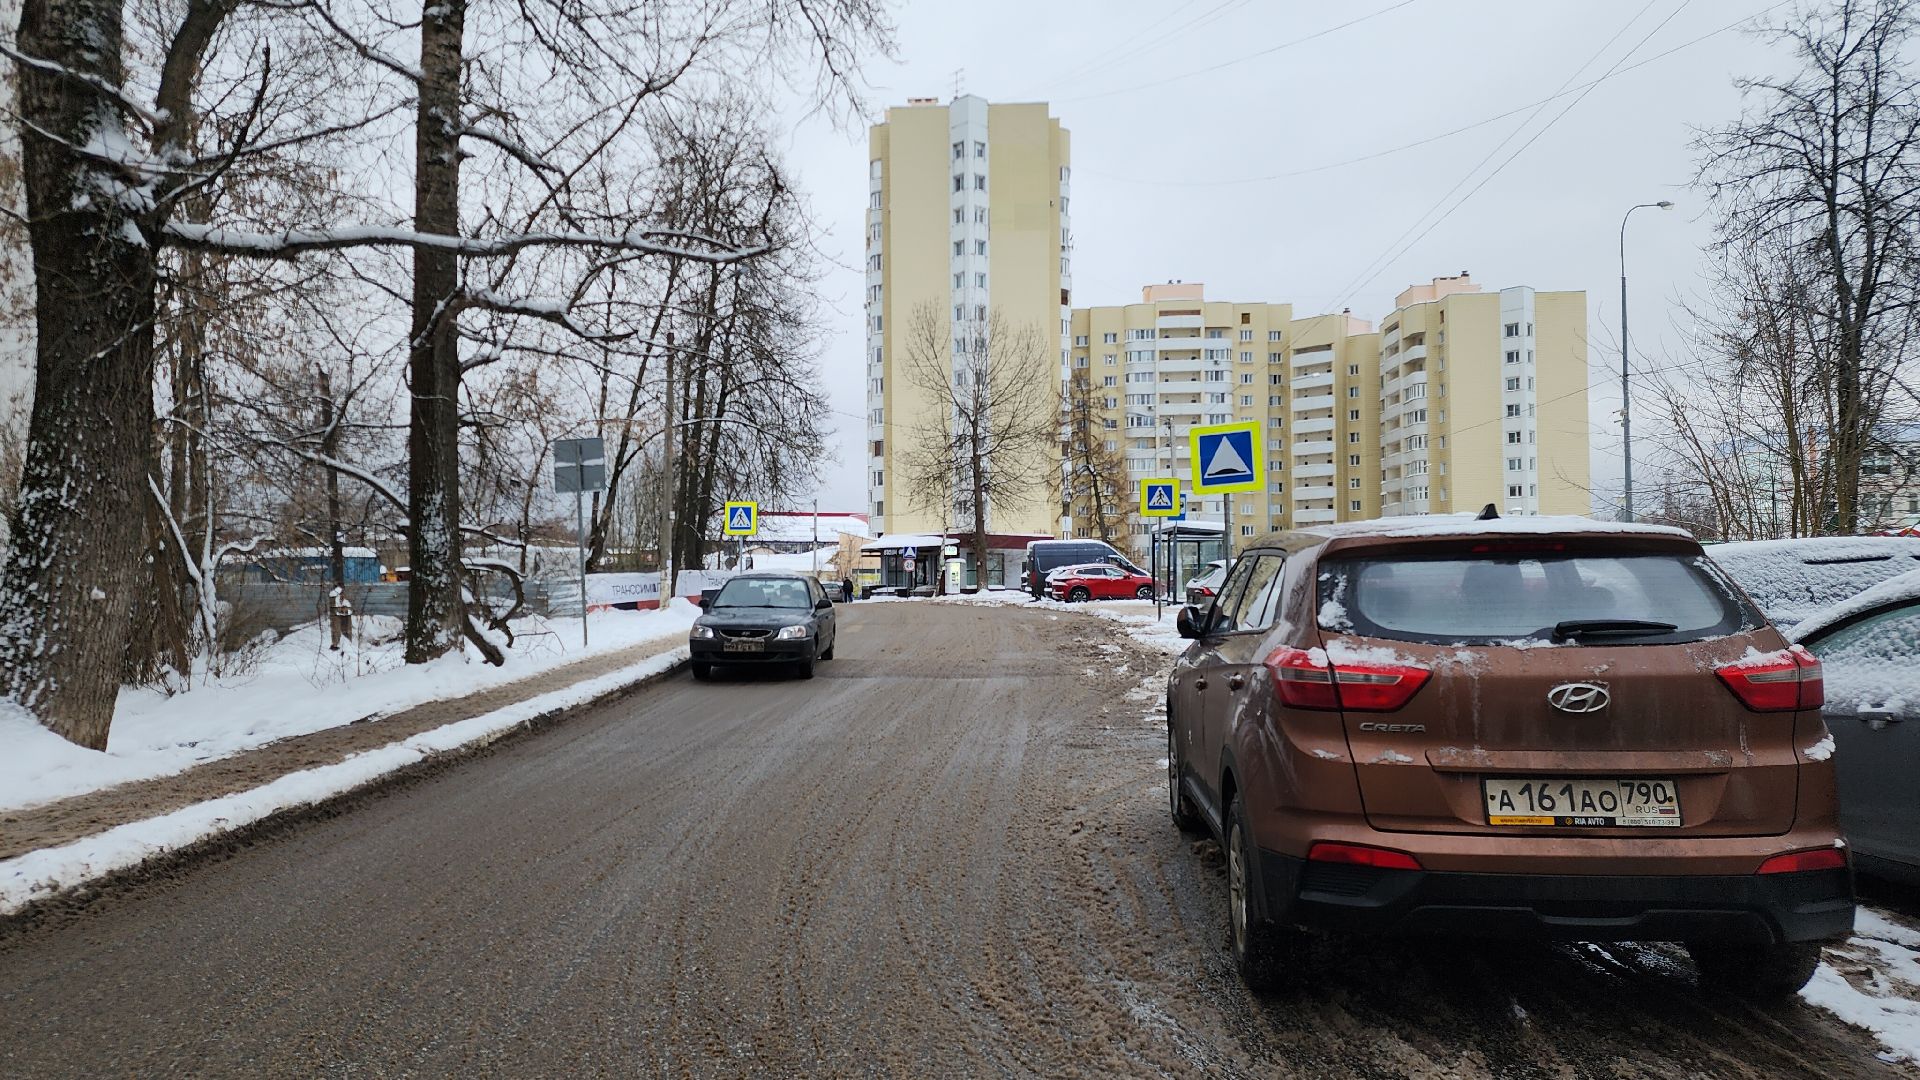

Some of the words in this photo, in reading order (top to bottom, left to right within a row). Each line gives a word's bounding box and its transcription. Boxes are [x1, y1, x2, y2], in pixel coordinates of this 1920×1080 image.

[906, 561, 914, 569] 20
[1359, 722, 1426, 733] CRETA
[1621, 781, 1668, 805] 790
[1636, 805, 1658, 814] RUS
[1574, 817, 1587, 825] RIA
[1587, 818, 1605, 826] AVTO
